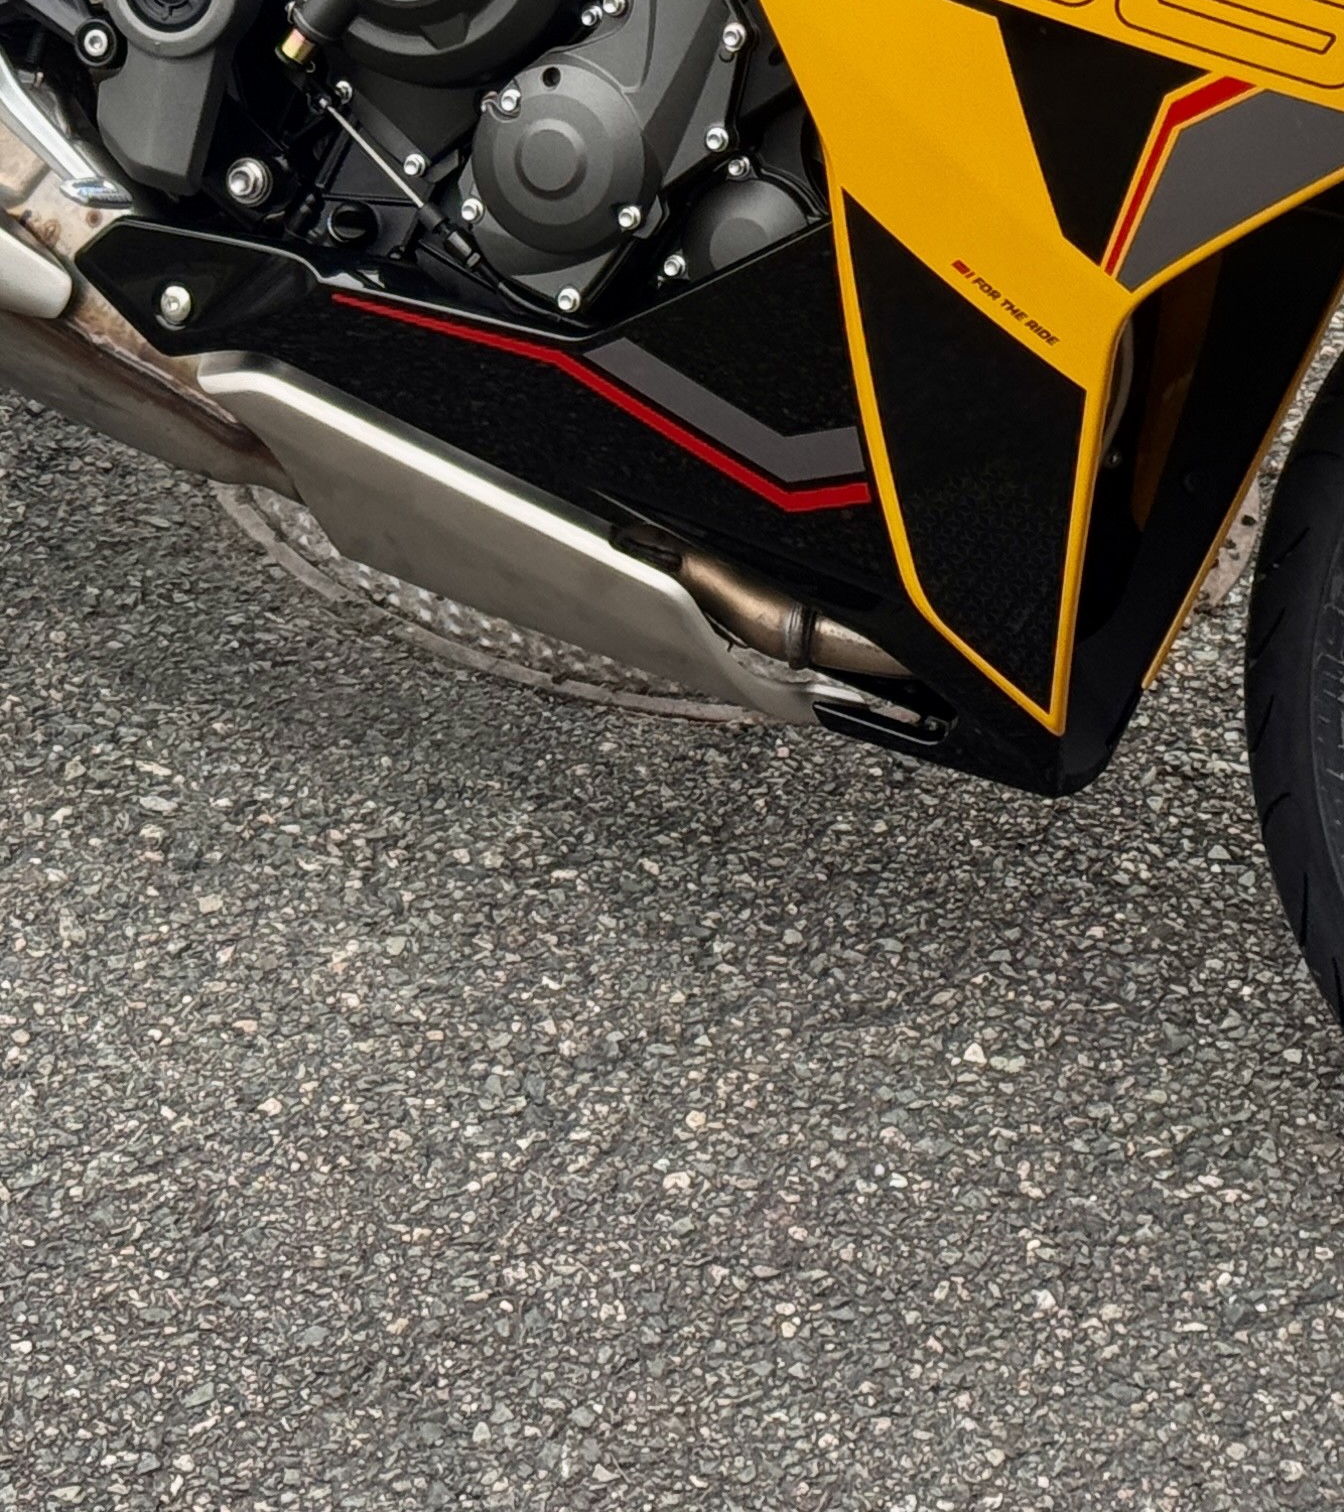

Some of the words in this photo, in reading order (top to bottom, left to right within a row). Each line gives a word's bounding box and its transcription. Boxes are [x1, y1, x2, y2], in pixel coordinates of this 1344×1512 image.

[971, 276, 1002, 301] FOR
[1000, 298, 1029, 322] THE
[1024, 319, 1061, 346] RIDE
